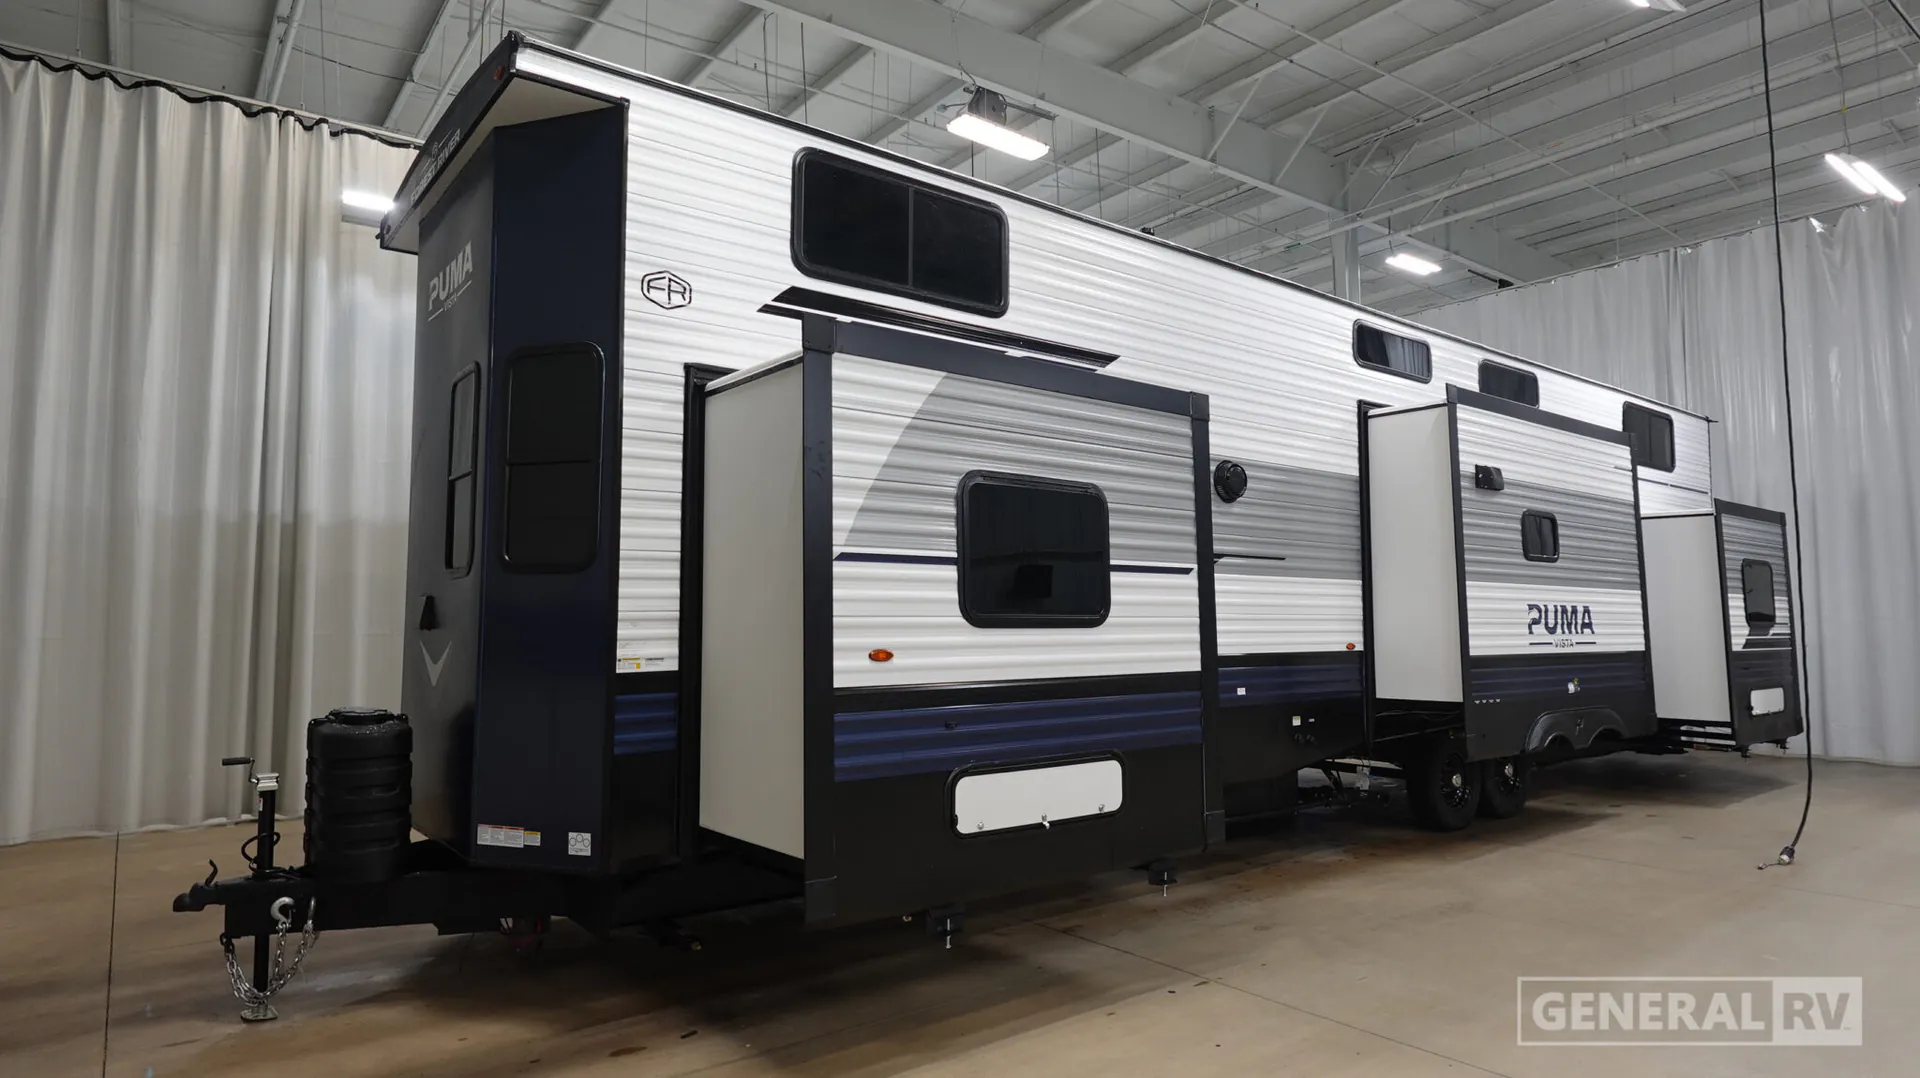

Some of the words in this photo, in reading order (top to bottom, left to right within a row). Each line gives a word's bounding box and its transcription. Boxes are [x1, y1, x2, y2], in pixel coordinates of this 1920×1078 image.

[437, 128, 461, 169] RIVER
[428, 240, 473, 311] PUMA
[646, 276, 687, 305] FR
[1527, 603, 1596, 636] PUMA
[1553, 638, 1575, 649] VISTA
